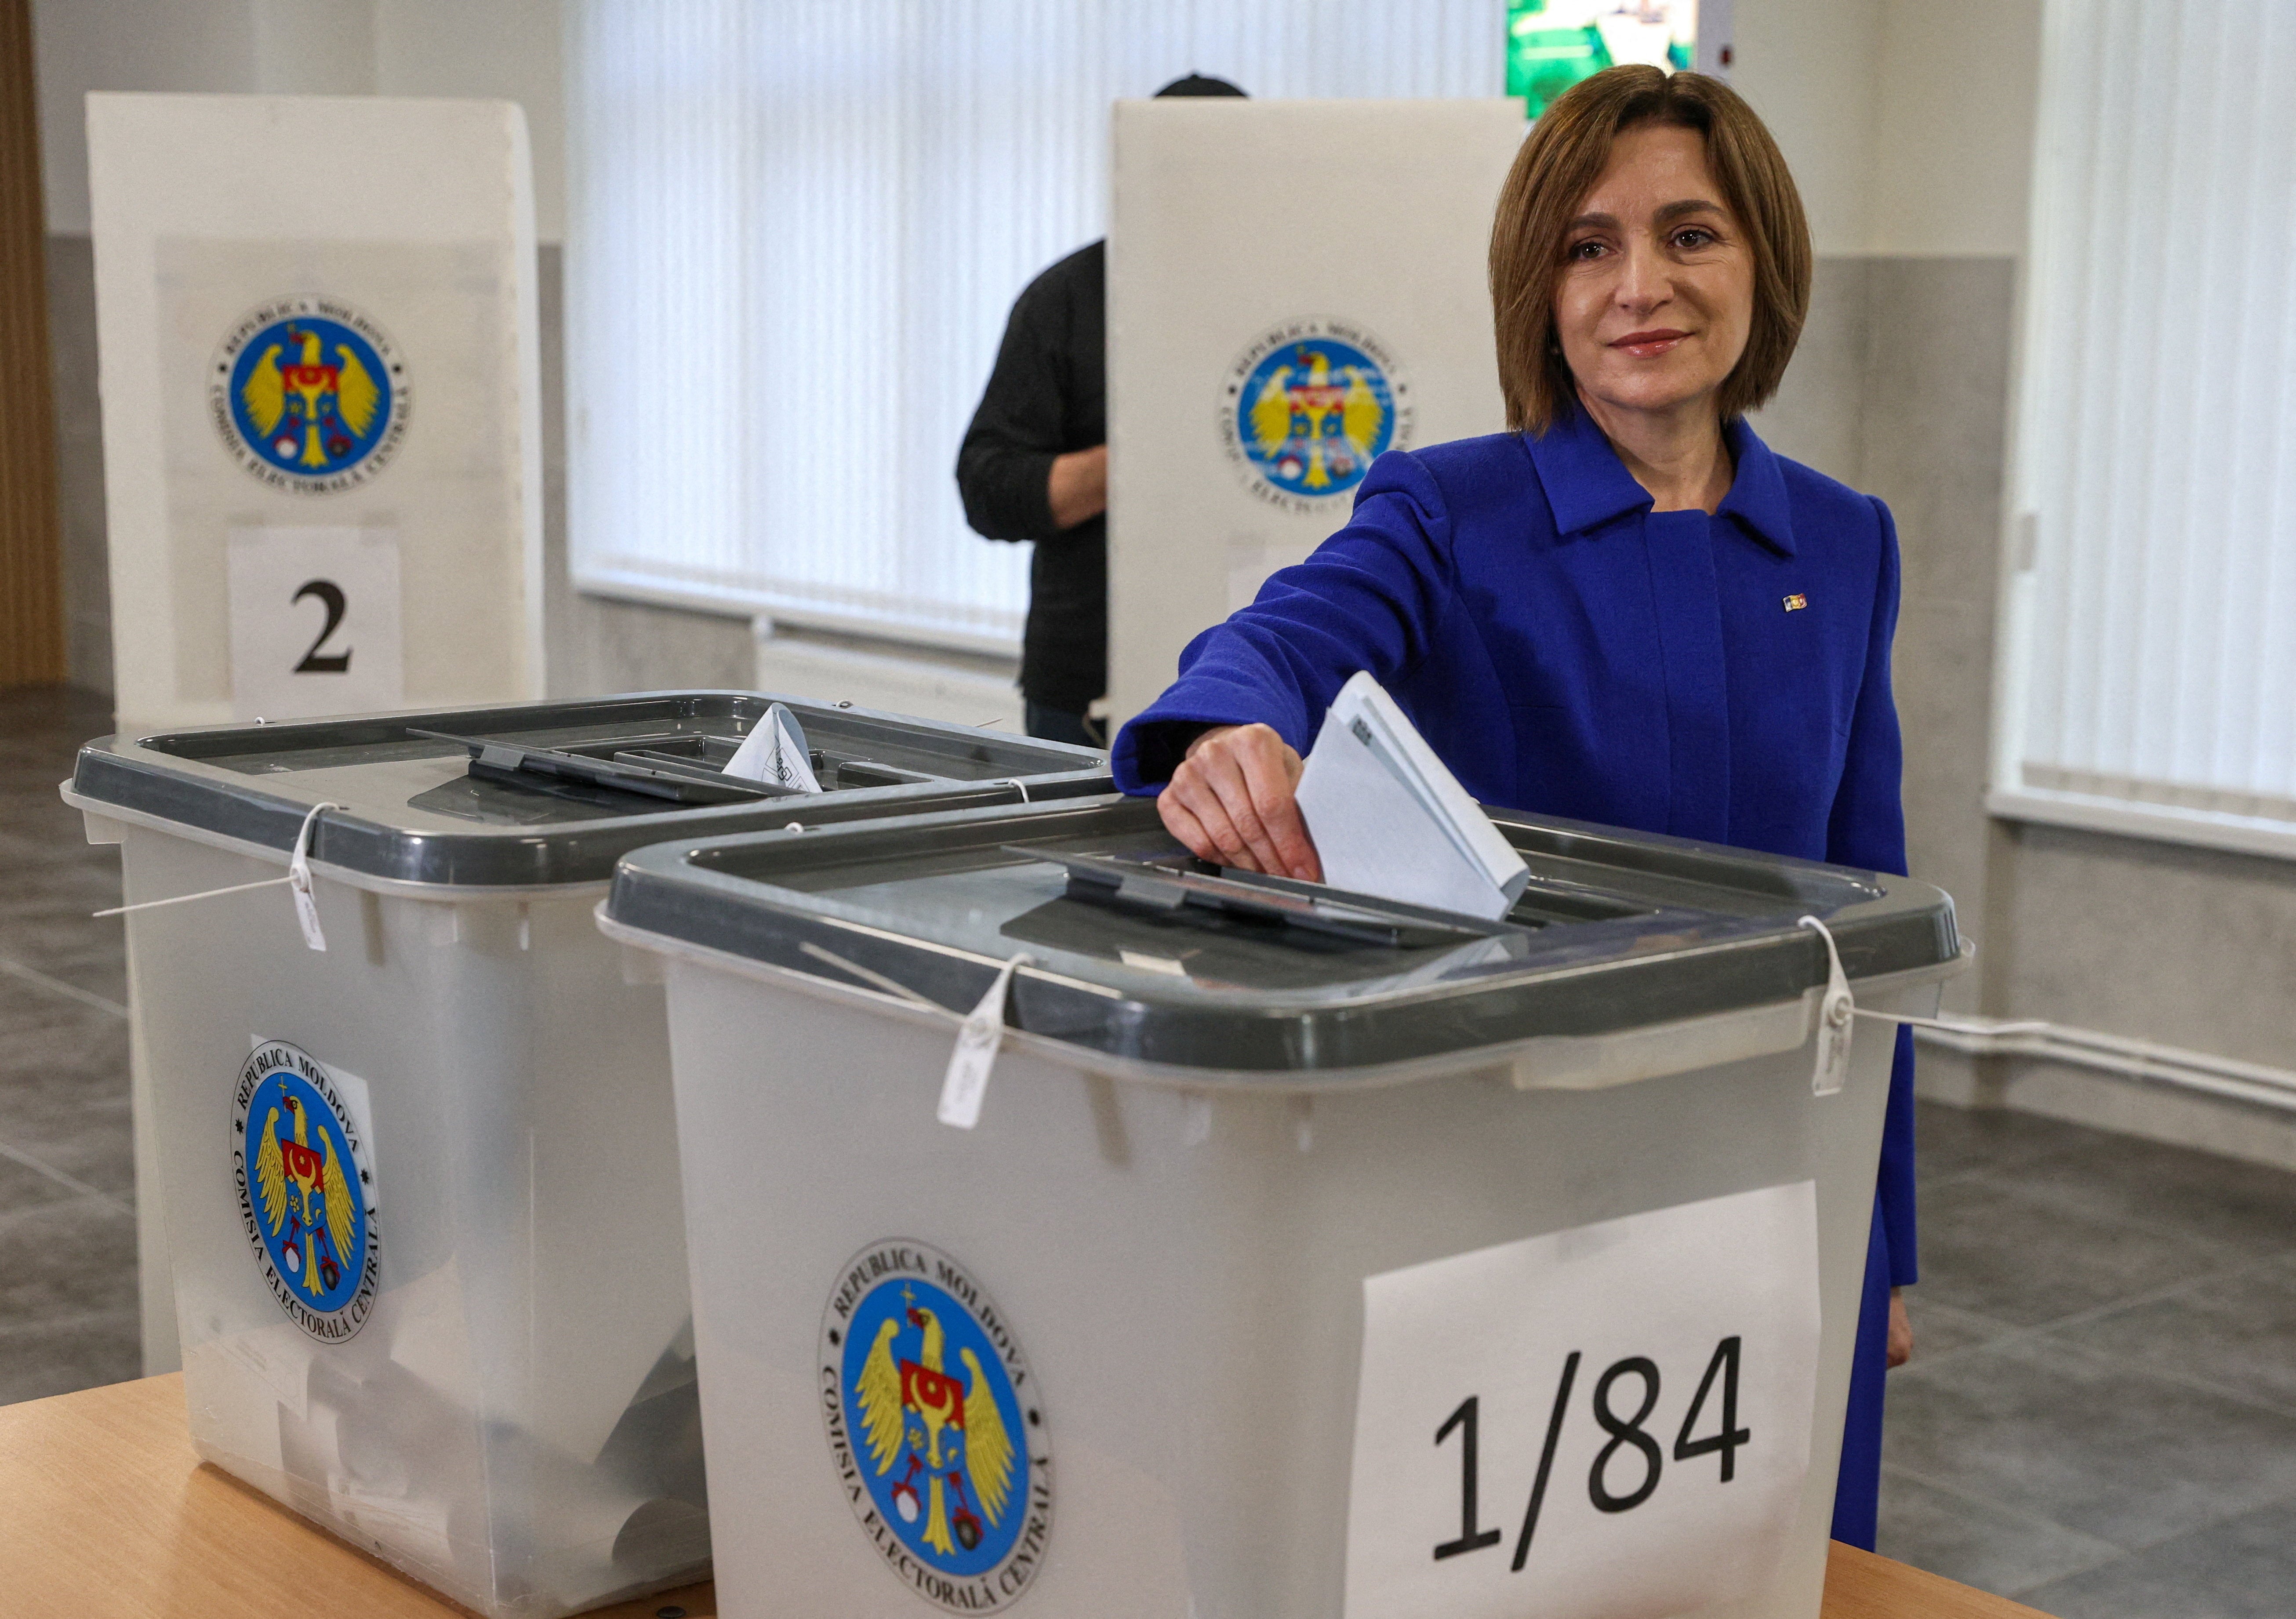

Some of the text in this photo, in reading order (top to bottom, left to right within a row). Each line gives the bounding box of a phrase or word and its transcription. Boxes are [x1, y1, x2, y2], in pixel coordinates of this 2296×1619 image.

[291, 578, 353, 674] 2
[237, 1049, 358, 1153] REPUBLICA MOLDOVA
[233, 1150, 378, 1339] COMISIA ELECTORALĂ CENTRALĂ
[833, 1249, 1026, 1389] REPUBLICA MOLDOVA
[823, 1365, 862, 1503] COMISIA
[864, 1510, 997, 1609] ELECTORALĂ
[1434, 1336, 1751, 1572] 1/84
